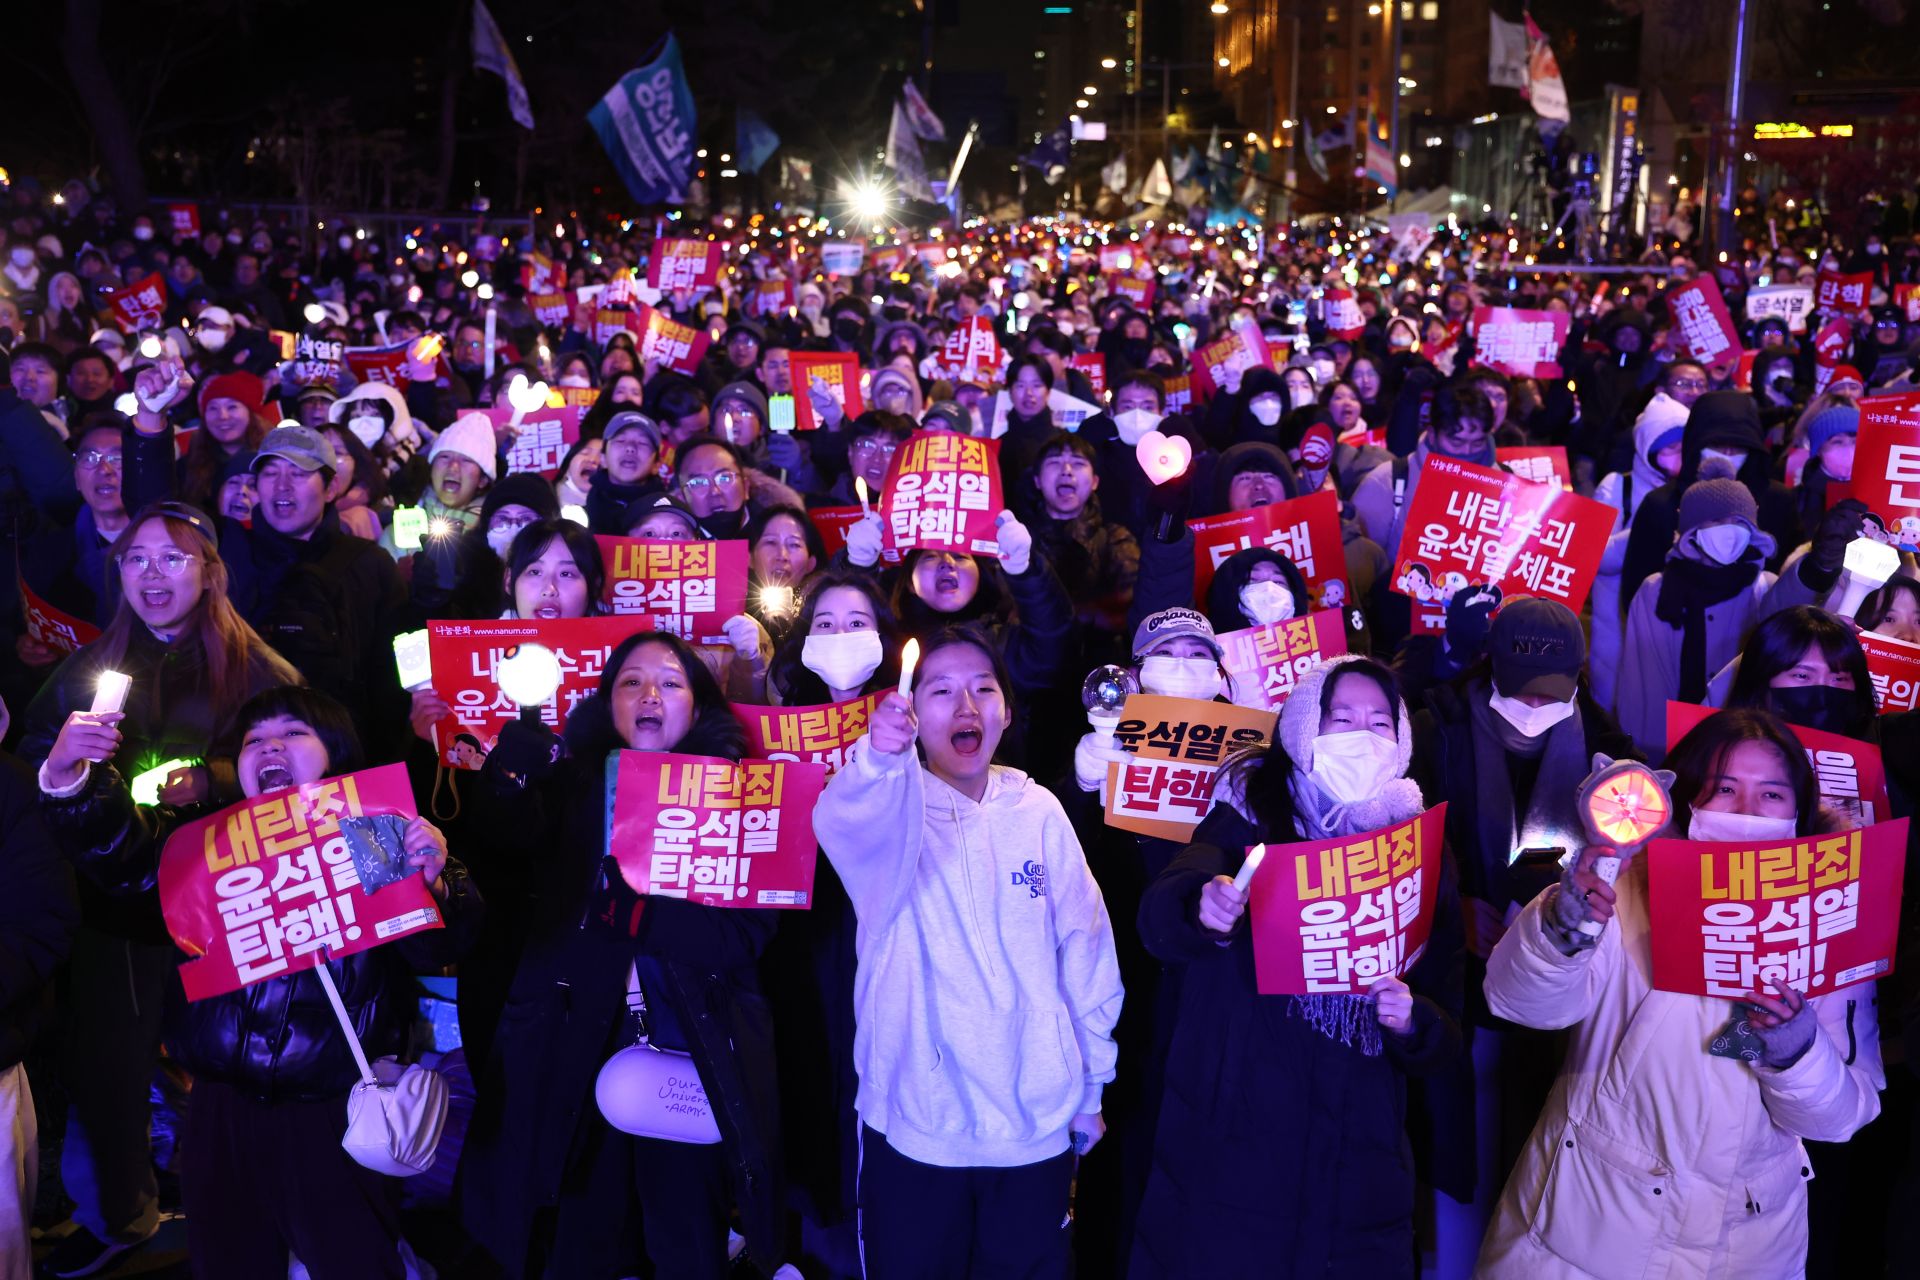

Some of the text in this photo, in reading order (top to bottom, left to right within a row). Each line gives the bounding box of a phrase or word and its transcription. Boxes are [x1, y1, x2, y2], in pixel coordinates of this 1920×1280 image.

[1819, 280, 1864, 307] 탄핵
[945, 328, 996, 364] 탄핵
[899, 436, 989, 475] 내란죄
[892, 472, 990, 512] 윤석열
[1462, 469, 1519, 491] www.nanum.com
[890, 508, 967, 548] 탄핵!
[1446, 490, 1576, 558] 내란수괴
[613, 543, 717, 579] 내란죄
[1513, 551, 1576, 598] 체포
[612, 578, 717, 614] 윤석열
[436, 625, 538, 636] 나눔문화 www.nanum.com
[654, 614, 694, 641] 핵!
[1220, 616, 1319, 674] 내란죄
[1513, 641, 1565, 656] NYC
[760, 695, 876, 752] 내란죄
[657, 763, 785, 809] 내란죄
[204, 775, 364, 874] 내란죄
[653, 807, 781, 855] 윤석열
[649, 853, 752, 901] 탄핵!
[1295, 817, 1422, 900] 내란죄
[1701, 830, 1862, 901] 내란죄
[1299, 868, 1422, 950] 윤석열
[1701, 881, 1860, 952] 윤석열
[227, 893, 362, 985] 탄핵!
[1302, 932, 1407, 993] 탄핵!
[1702, 942, 1828, 997] 탄핵!
